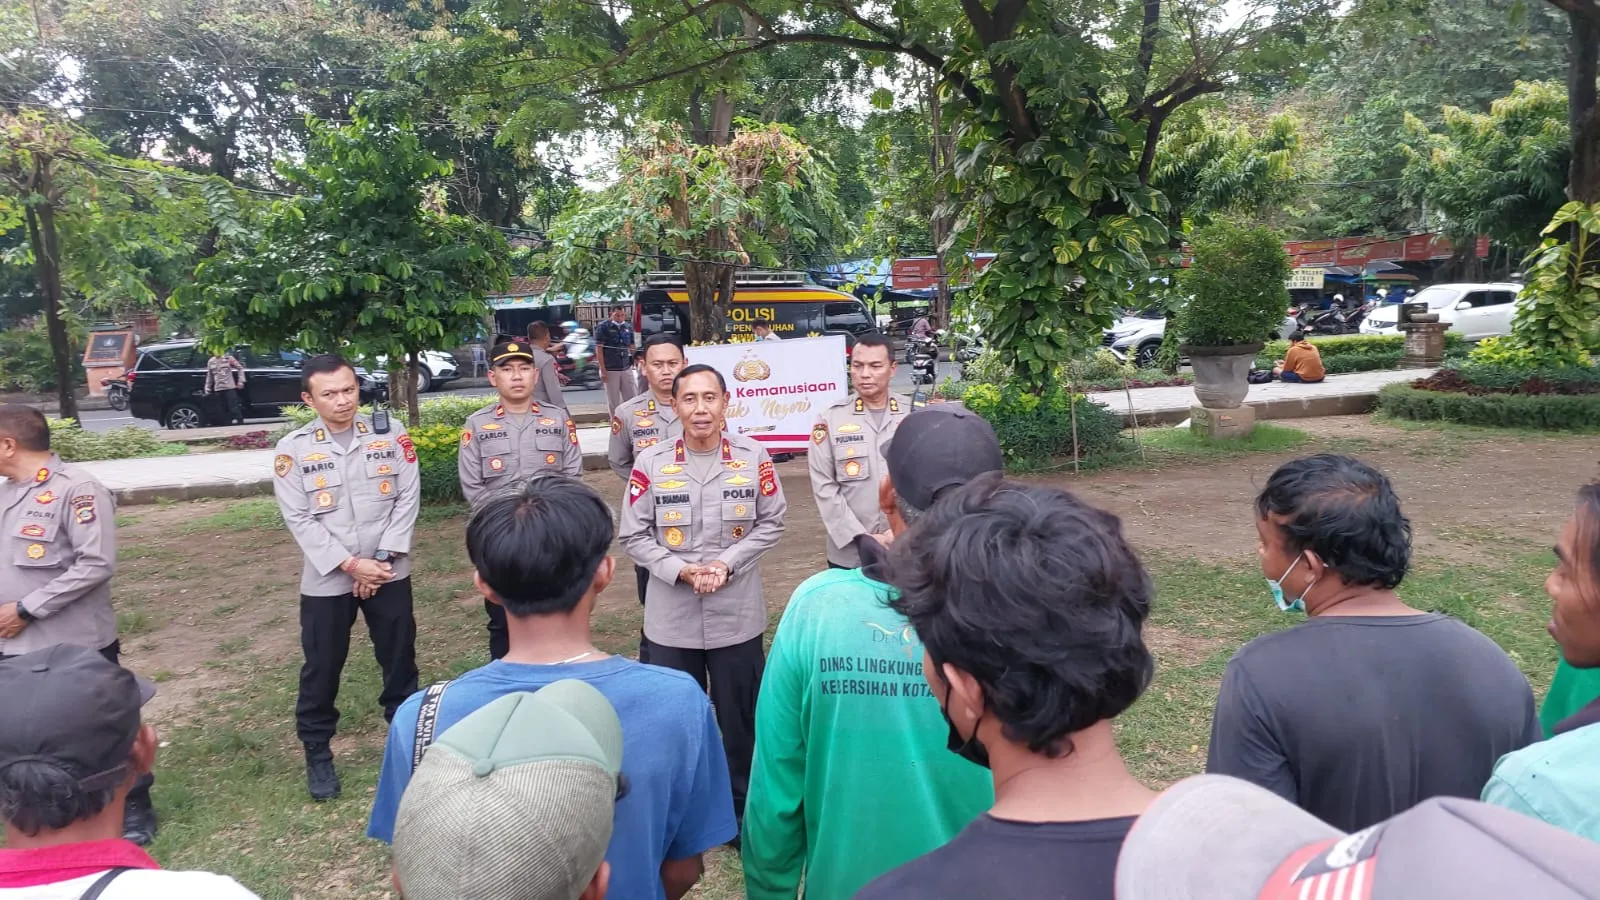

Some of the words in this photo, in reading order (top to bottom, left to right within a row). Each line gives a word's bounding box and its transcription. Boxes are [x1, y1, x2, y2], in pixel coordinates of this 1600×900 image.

[733, 323, 795, 332] PENUHAN
[736, 382, 837, 398] Kemanusiaan
[759, 397, 812, 421] Negeri
[480, 431, 508, 440] CARLOS
[633, 428, 660, 436] HENGKY
[366, 450, 396, 461] POLRI
[302, 461, 335, 474] MARIO
[723, 488, 755, 499] POLRI
[26, 510, 56, 519] POLRI
[820, 656, 853, 673] DINAS
[902, 683, 936, 697] KOTA
